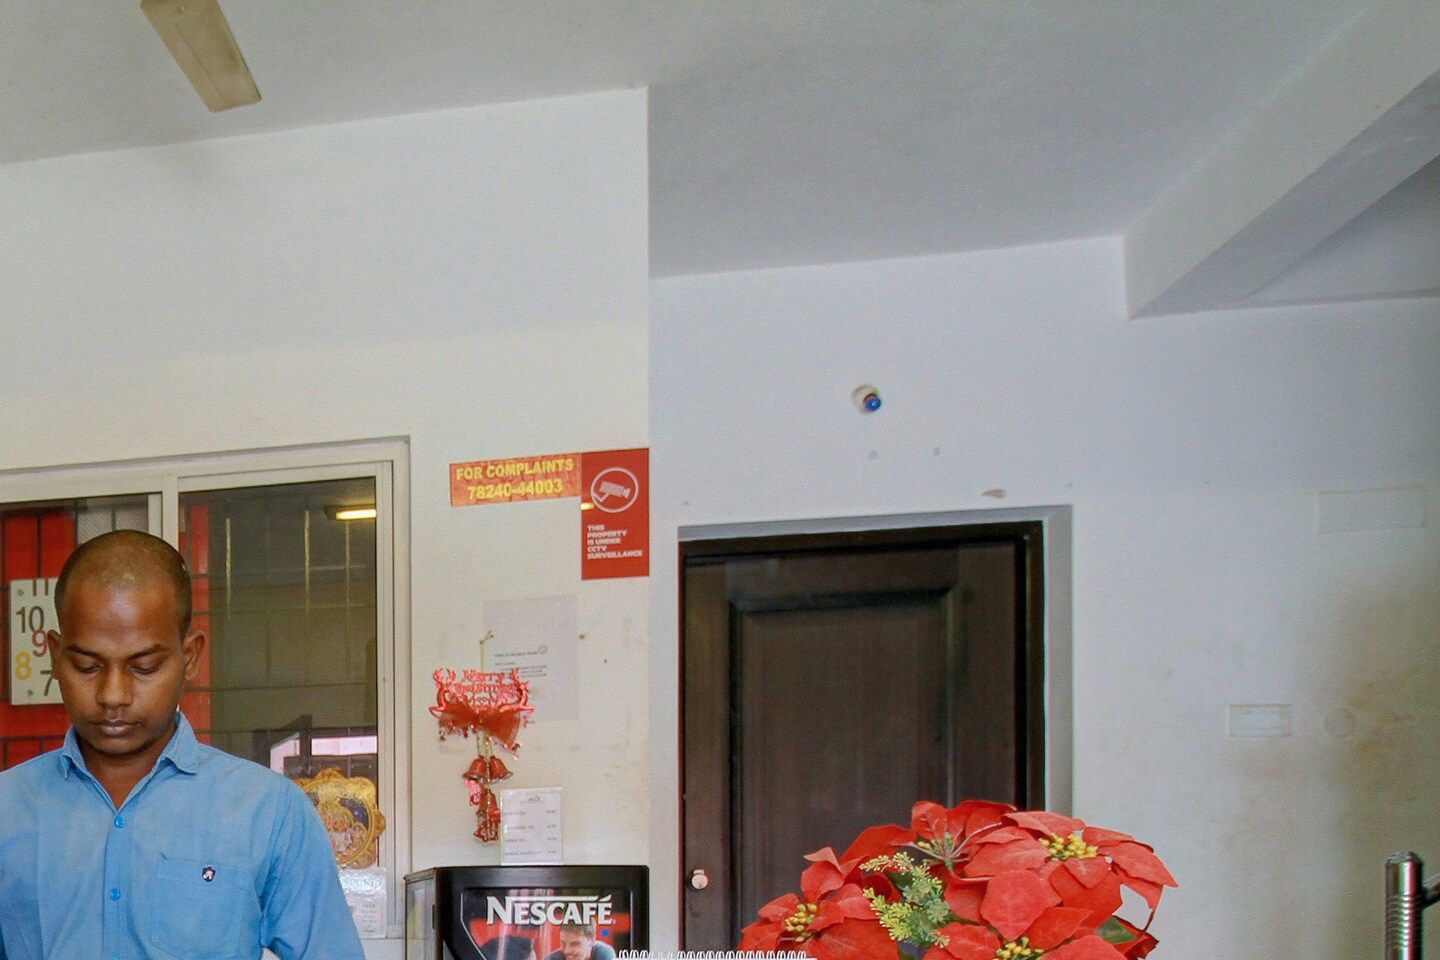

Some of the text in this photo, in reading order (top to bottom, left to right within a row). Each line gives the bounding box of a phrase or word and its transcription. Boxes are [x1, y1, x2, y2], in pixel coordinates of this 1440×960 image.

[456, 458, 574, 480] FOR COMPLAINTS
[587, 545, 608, 553] CCTV
[15, 606, 45, 634] 10
[31, 629, 48, 657] 9
[15, 650, 33, 681] 8
[486, 894, 613, 926] NESCAFÉ
